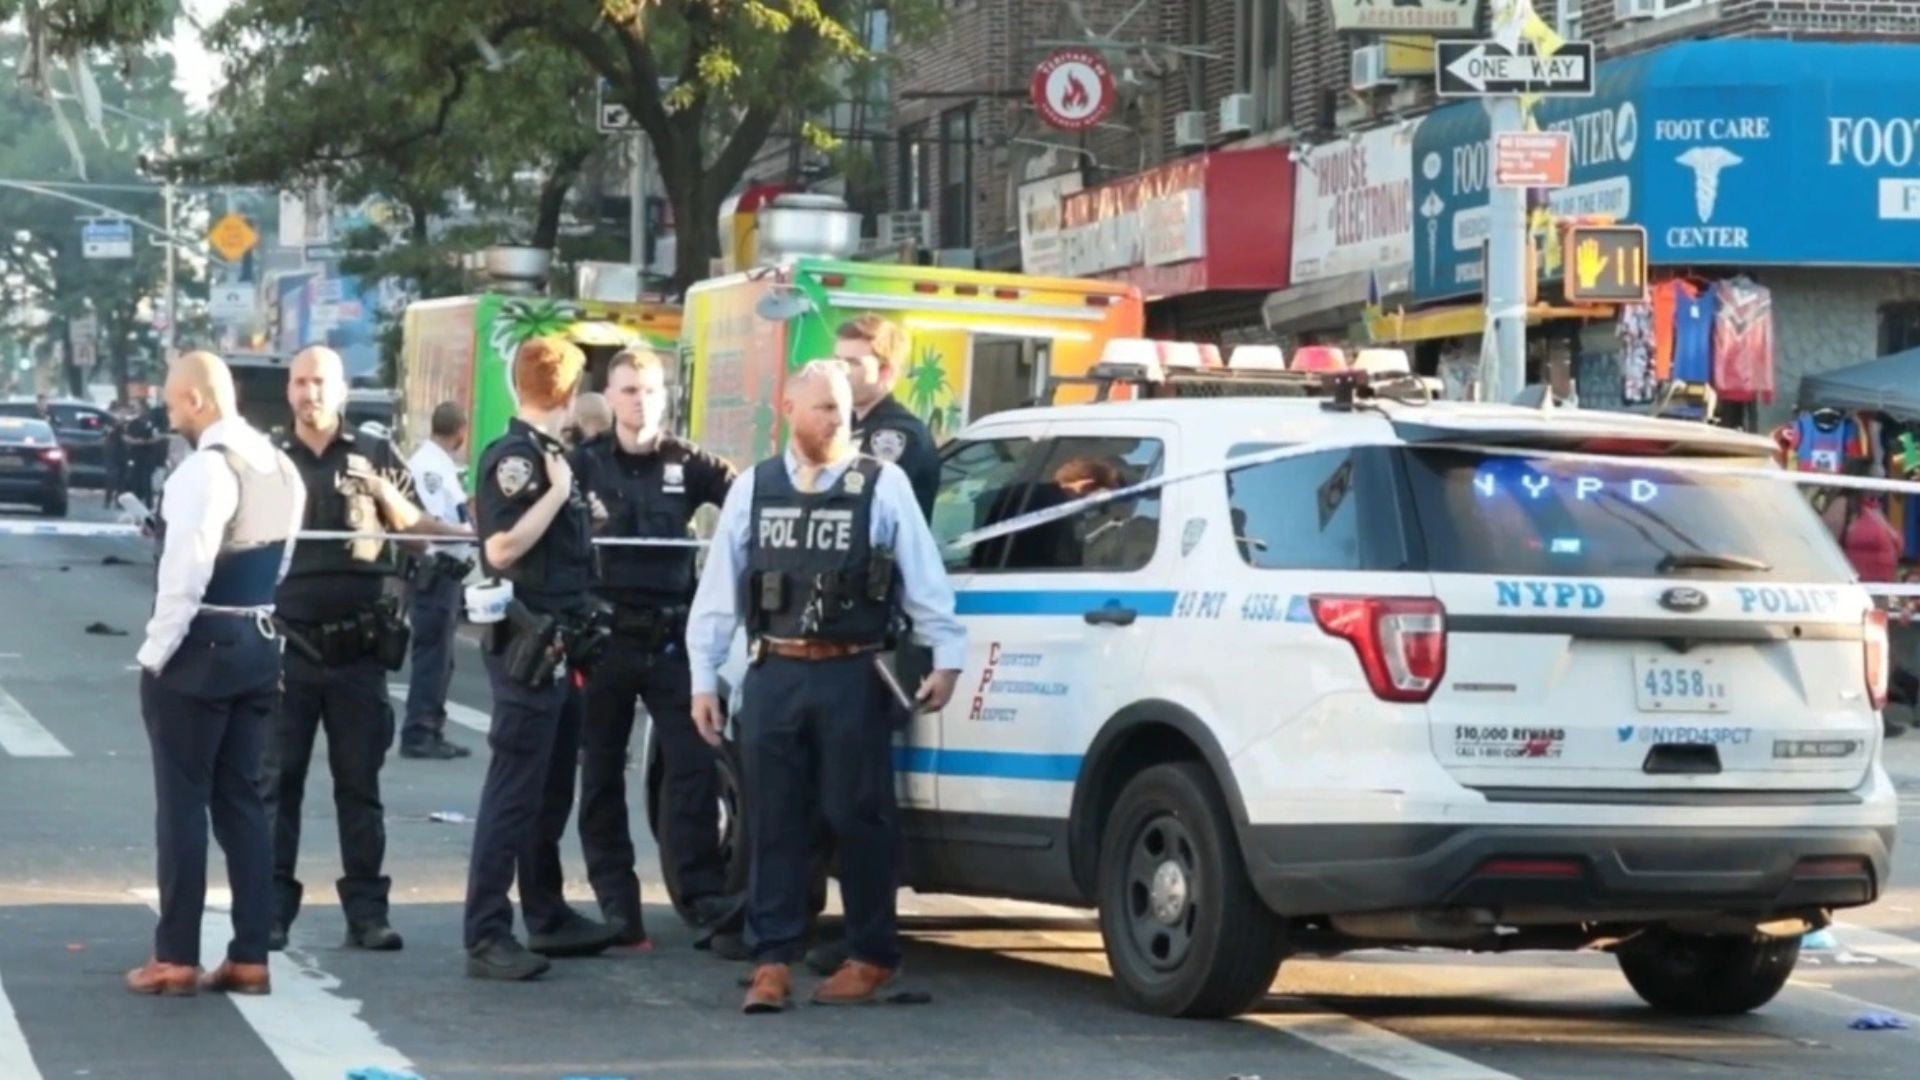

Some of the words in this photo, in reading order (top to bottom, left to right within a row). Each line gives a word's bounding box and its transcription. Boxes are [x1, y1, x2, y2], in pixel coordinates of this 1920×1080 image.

[1467, 58, 1509, 79] ONE
[1530, 58, 1575, 79] WAY
[1547, 108, 1616, 168] NTER
[1655, 119, 1705, 141] FOOT
[1708, 116, 1771, 140] CARE
[1316, 146, 1368, 197] HOUSE
[1666, 226, 1750, 249] CENTER
[1616, 245, 1641, 287] 11
[759, 518, 851, 551] POLICE
[1495, 580, 1605, 609] NYPD
[1644, 668, 1705, 697] 4358
[1455, 726, 1509, 743] $10,000
[1511, 727, 1566, 742] REWARD
[1638, 726, 1753, 745] @NYPD43PCT
